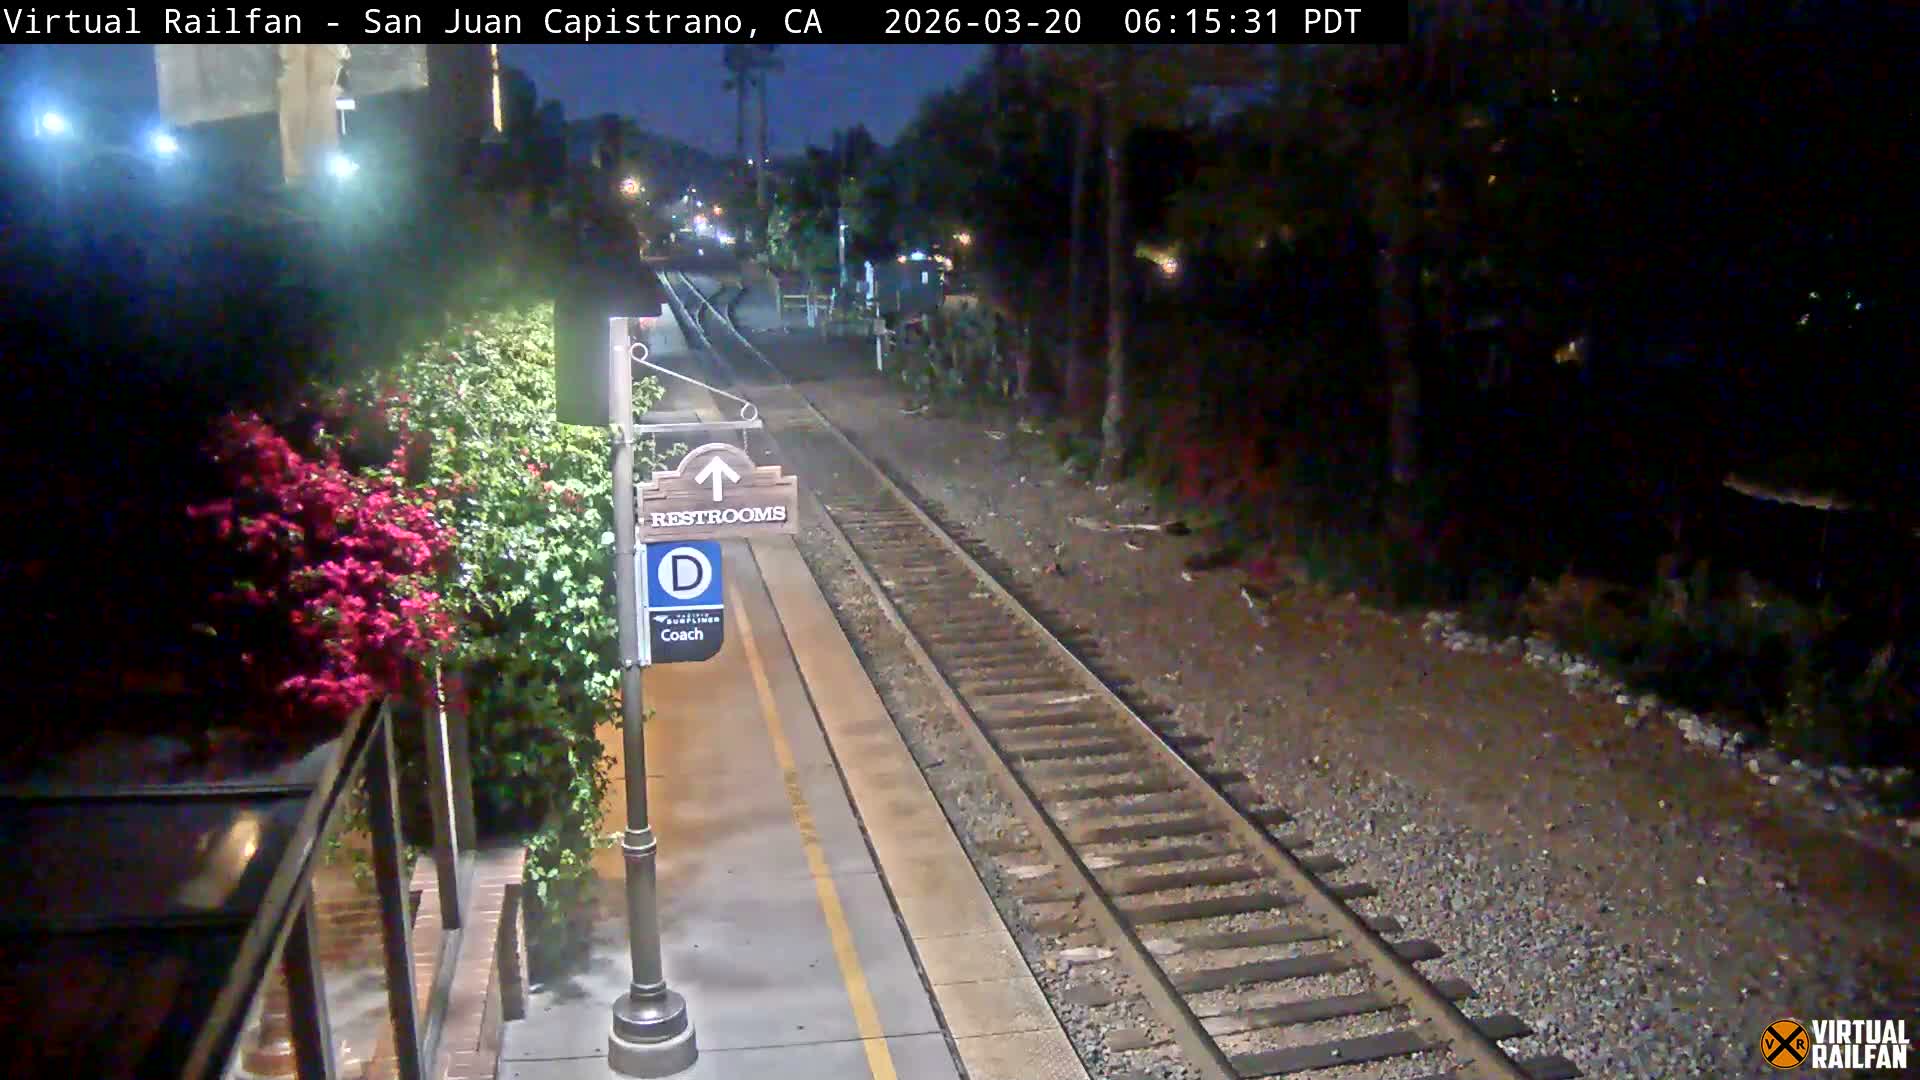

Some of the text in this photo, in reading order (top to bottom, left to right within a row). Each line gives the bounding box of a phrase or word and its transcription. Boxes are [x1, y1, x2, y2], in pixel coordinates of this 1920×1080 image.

[650, 505, 787, 528] RESTROOMS
[671, 554, 703, 591] D
[660, 627, 704, 641] Coach
